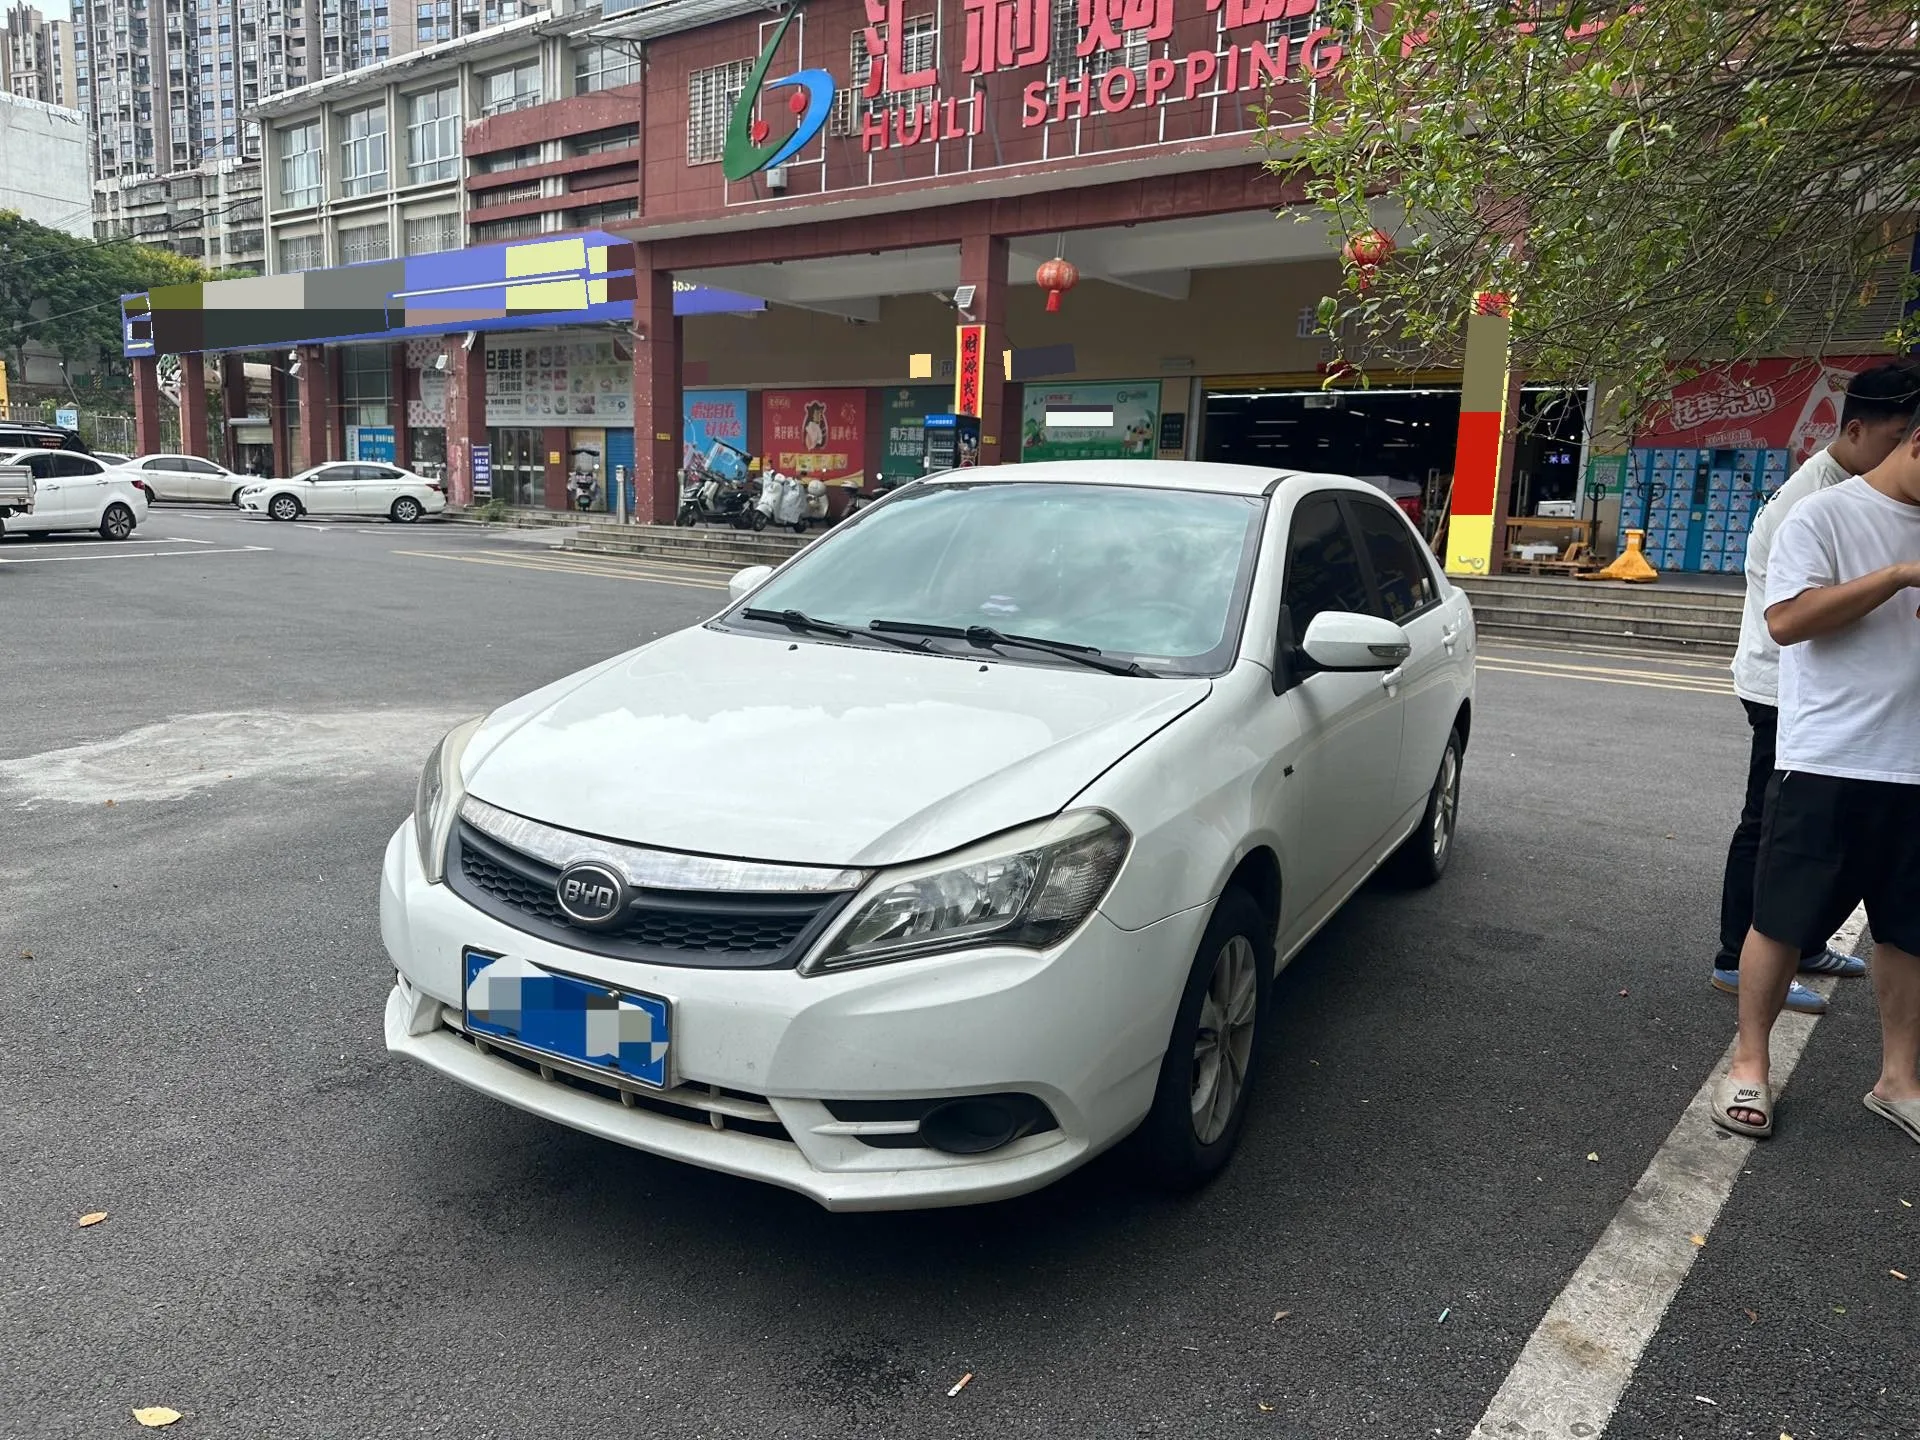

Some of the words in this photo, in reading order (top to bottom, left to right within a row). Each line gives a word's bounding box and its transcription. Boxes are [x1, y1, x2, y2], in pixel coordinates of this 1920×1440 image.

[864, 0, 1315, 98] 汇利购
[862, 91, 985, 153] HUILI
[1023, 27, 1344, 128] SHOPPING
[486, 348, 522, 370] 日蛋糕
[1673, 387, 1773, 426] 花生牛奶
[564, 879, 614, 909] BYD
[1738, 1088, 1762, 1098] NIKE
